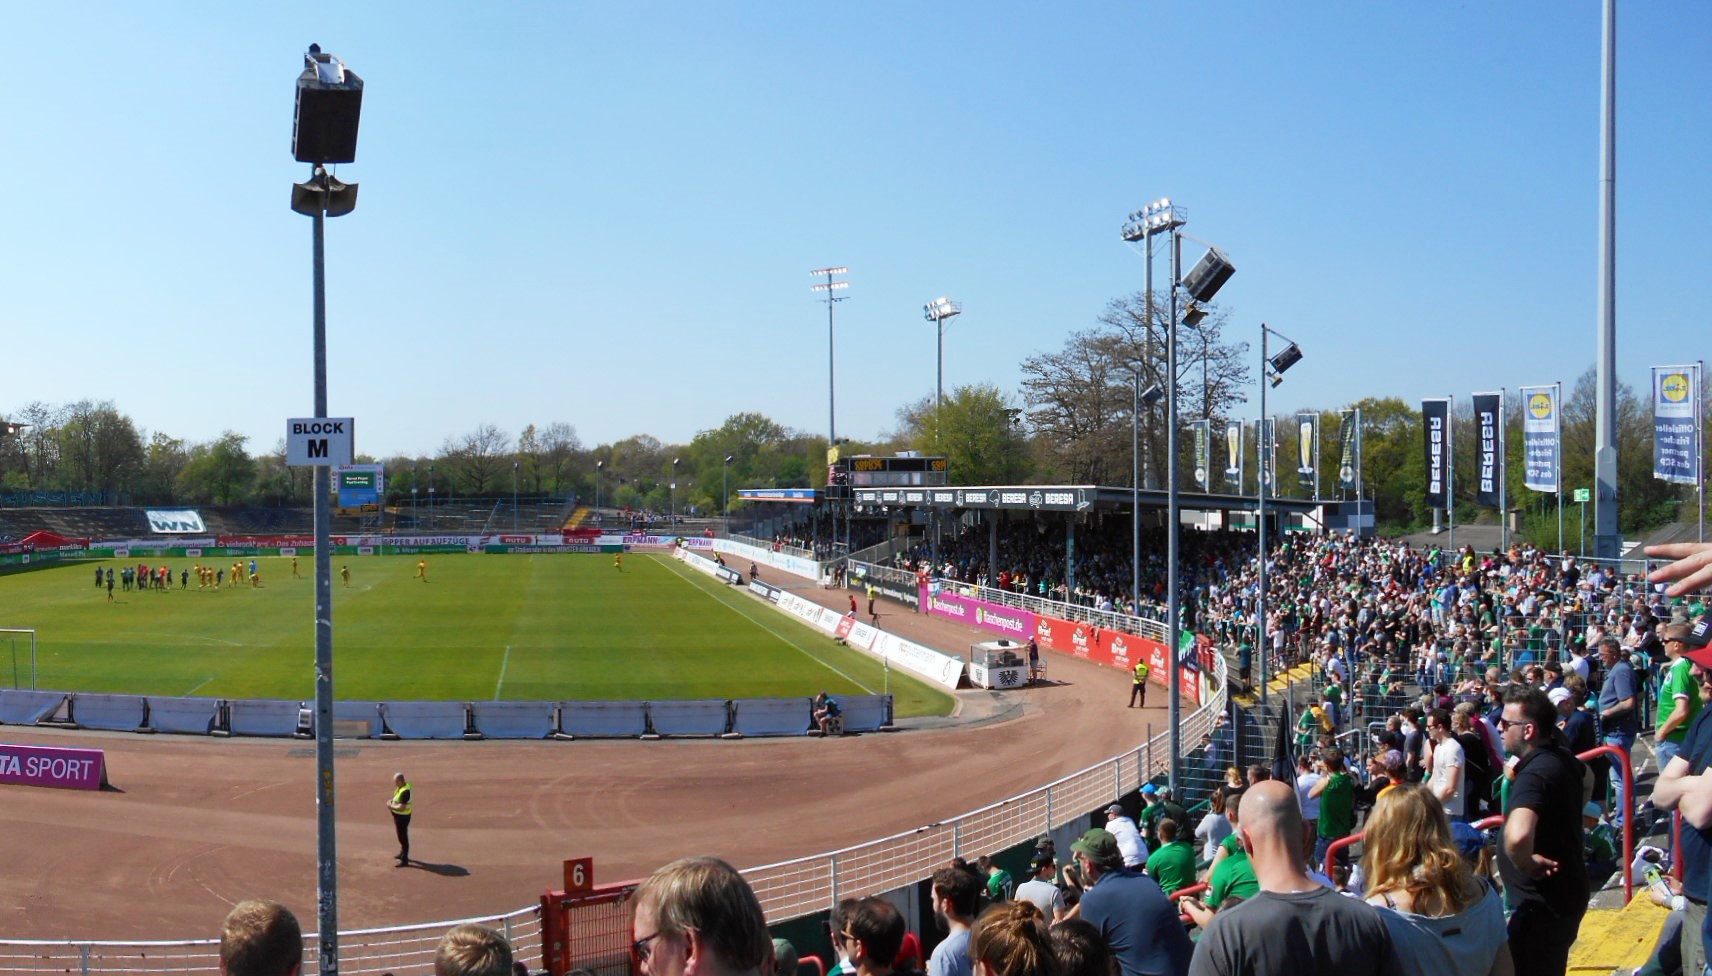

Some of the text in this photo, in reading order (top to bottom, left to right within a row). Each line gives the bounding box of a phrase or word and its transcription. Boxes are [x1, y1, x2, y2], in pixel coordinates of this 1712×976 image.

[293, 423, 344, 434] BLOCK
[308, 438, 328, 458] M
[1002, 493, 1026, 504] BERESA
[1045, 493, 1074, 505] BERESA
[152, 520, 200, 531] WN
[25, 757, 94, 780] SPORT
[573, 863, 584, 886] 6
